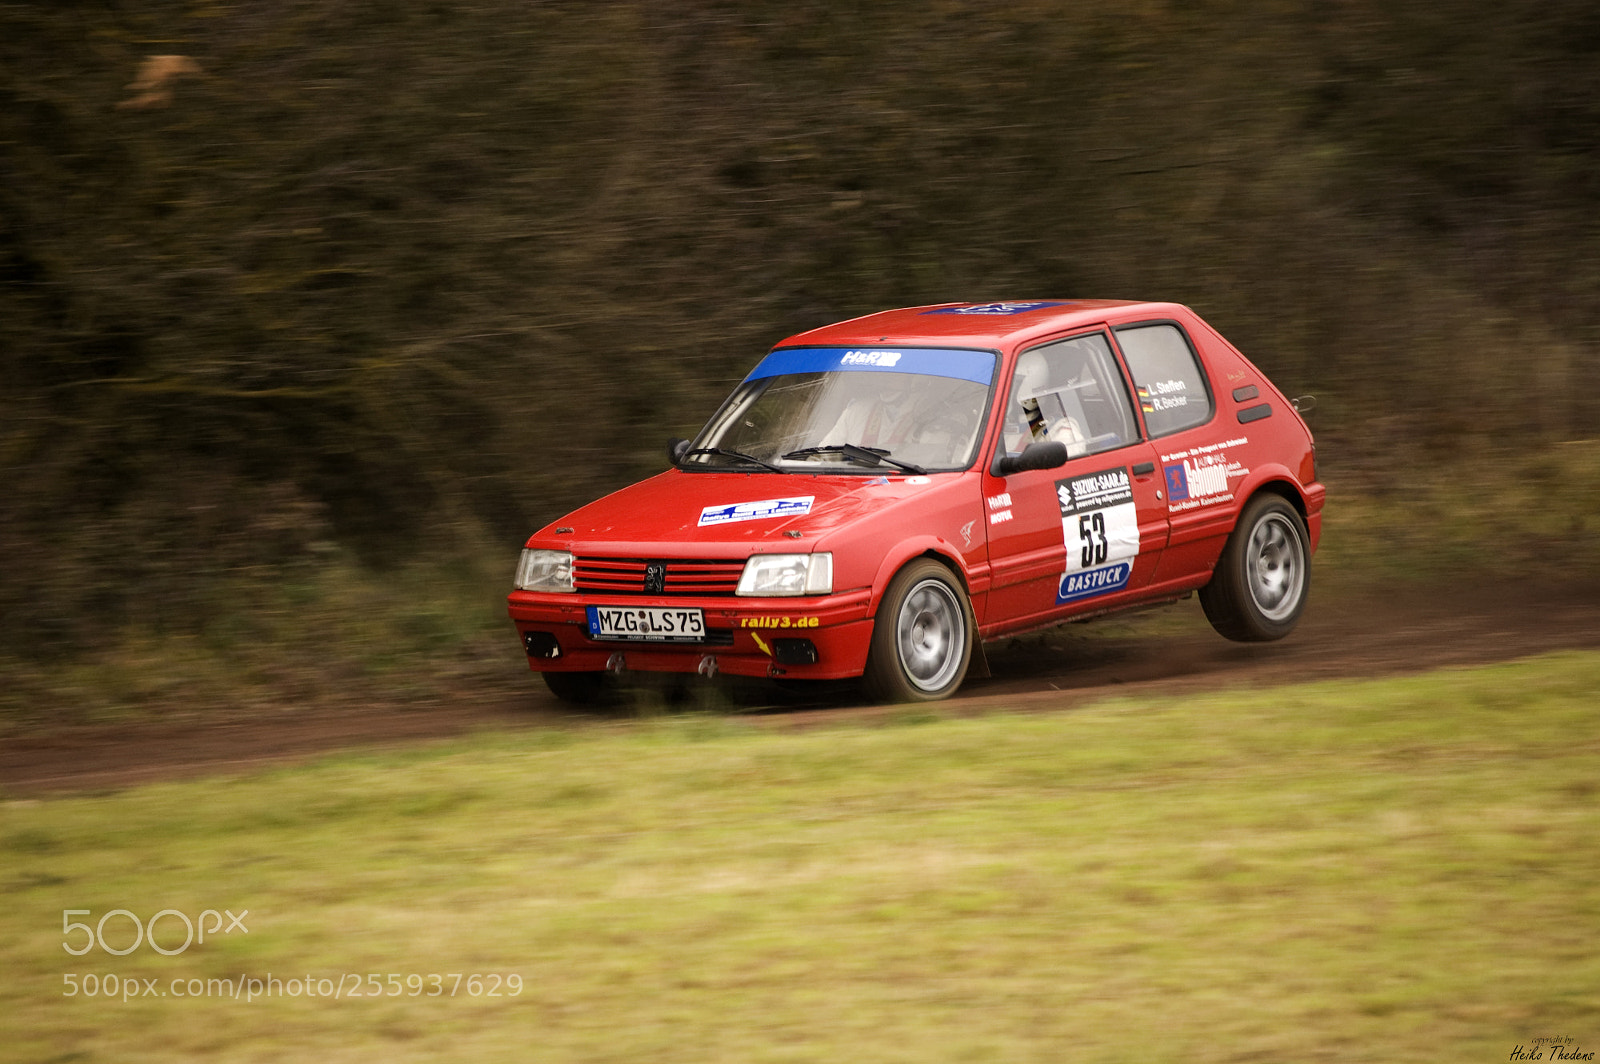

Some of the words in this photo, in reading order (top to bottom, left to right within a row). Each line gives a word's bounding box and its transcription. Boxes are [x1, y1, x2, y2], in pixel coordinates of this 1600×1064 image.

[1156, 380, 1186, 394] Steffen
[1162, 395, 1188, 409] Becker
[1071, 470, 1130, 496] SUZUKI-SAAR.de
[990, 509, 1013, 525] MOTUL
[1079, 512, 1108, 568] 53
[1067, 566, 1122, 593] BASTUCK
[599, 610, 638, 631] MZG
[741, 616, 819, 629] rally3.de
